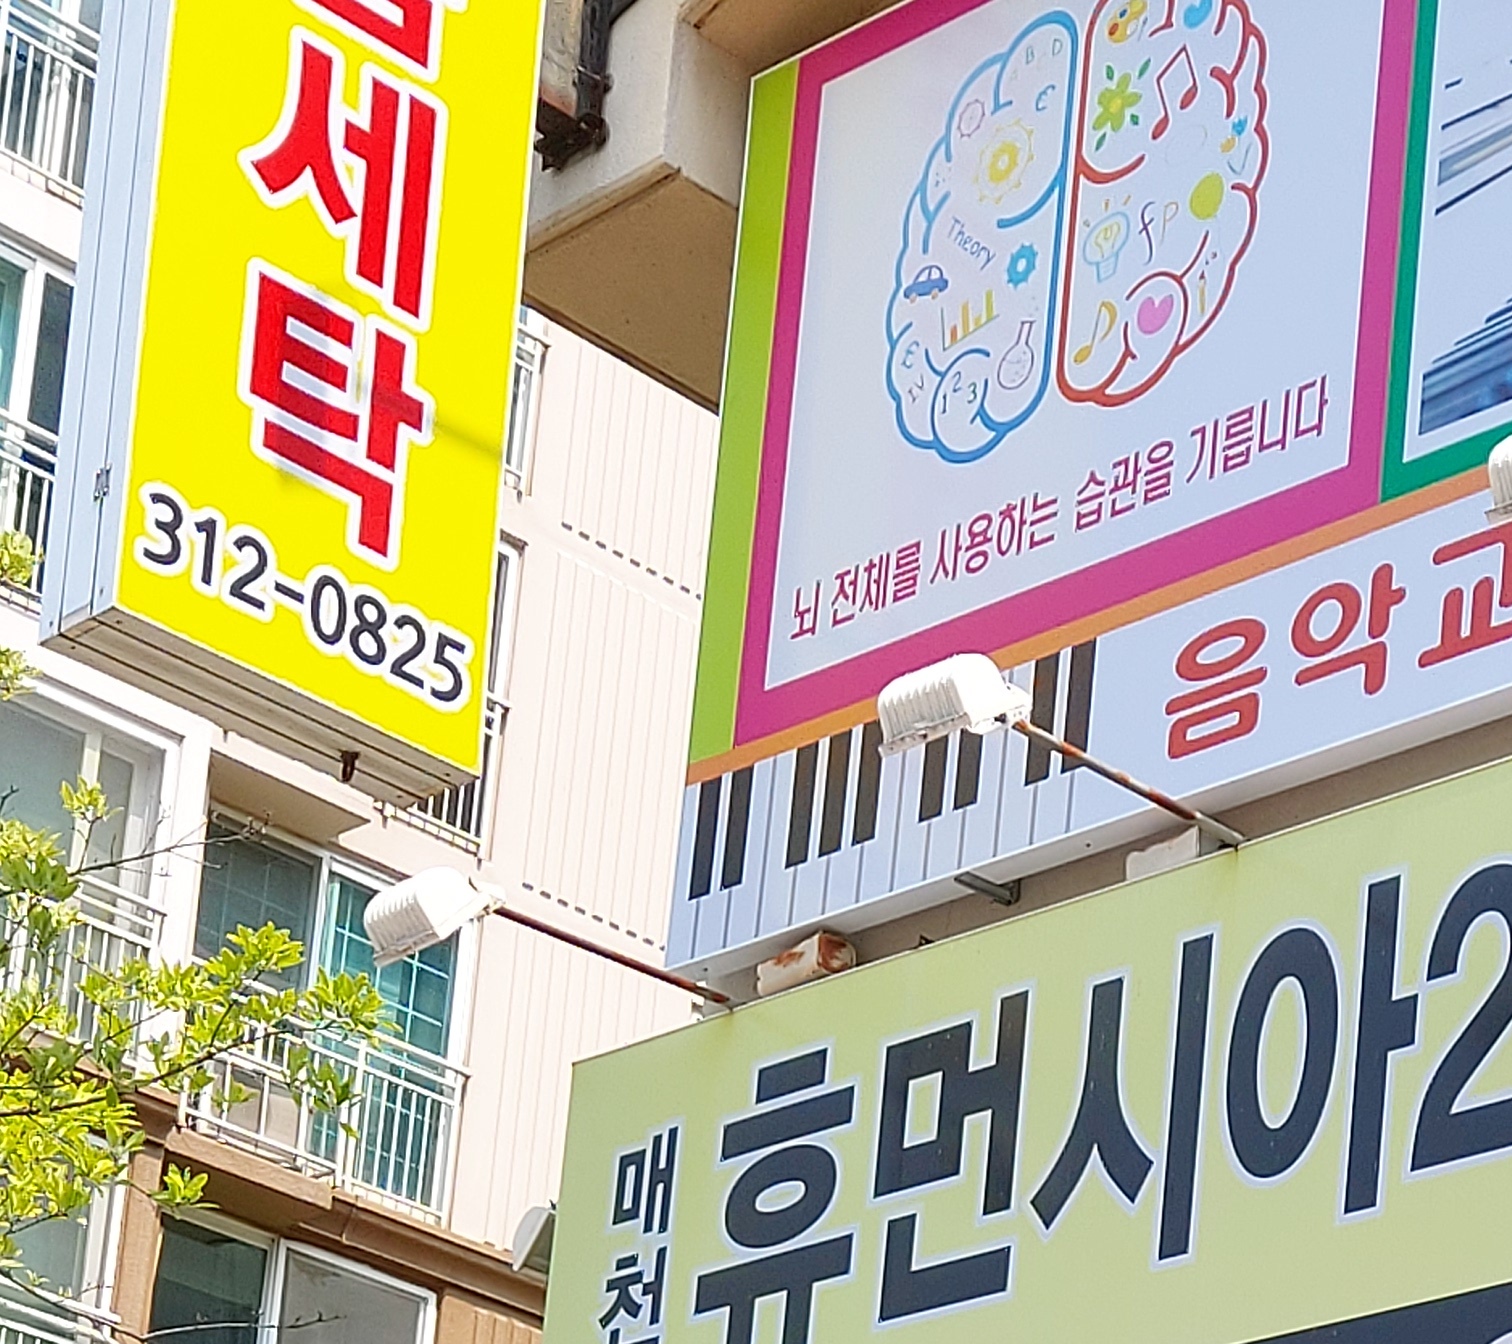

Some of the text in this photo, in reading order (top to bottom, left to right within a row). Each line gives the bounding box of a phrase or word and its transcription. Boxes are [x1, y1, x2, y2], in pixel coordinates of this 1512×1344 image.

[250, 0, 438, 560] 세탁
[946, 216, 996, 271] Theory
[142, 490, 468, 704] 312-0825
[789, 373, 1329, 641] 뇌 전체를 사용하는 습관을 기릅니다
